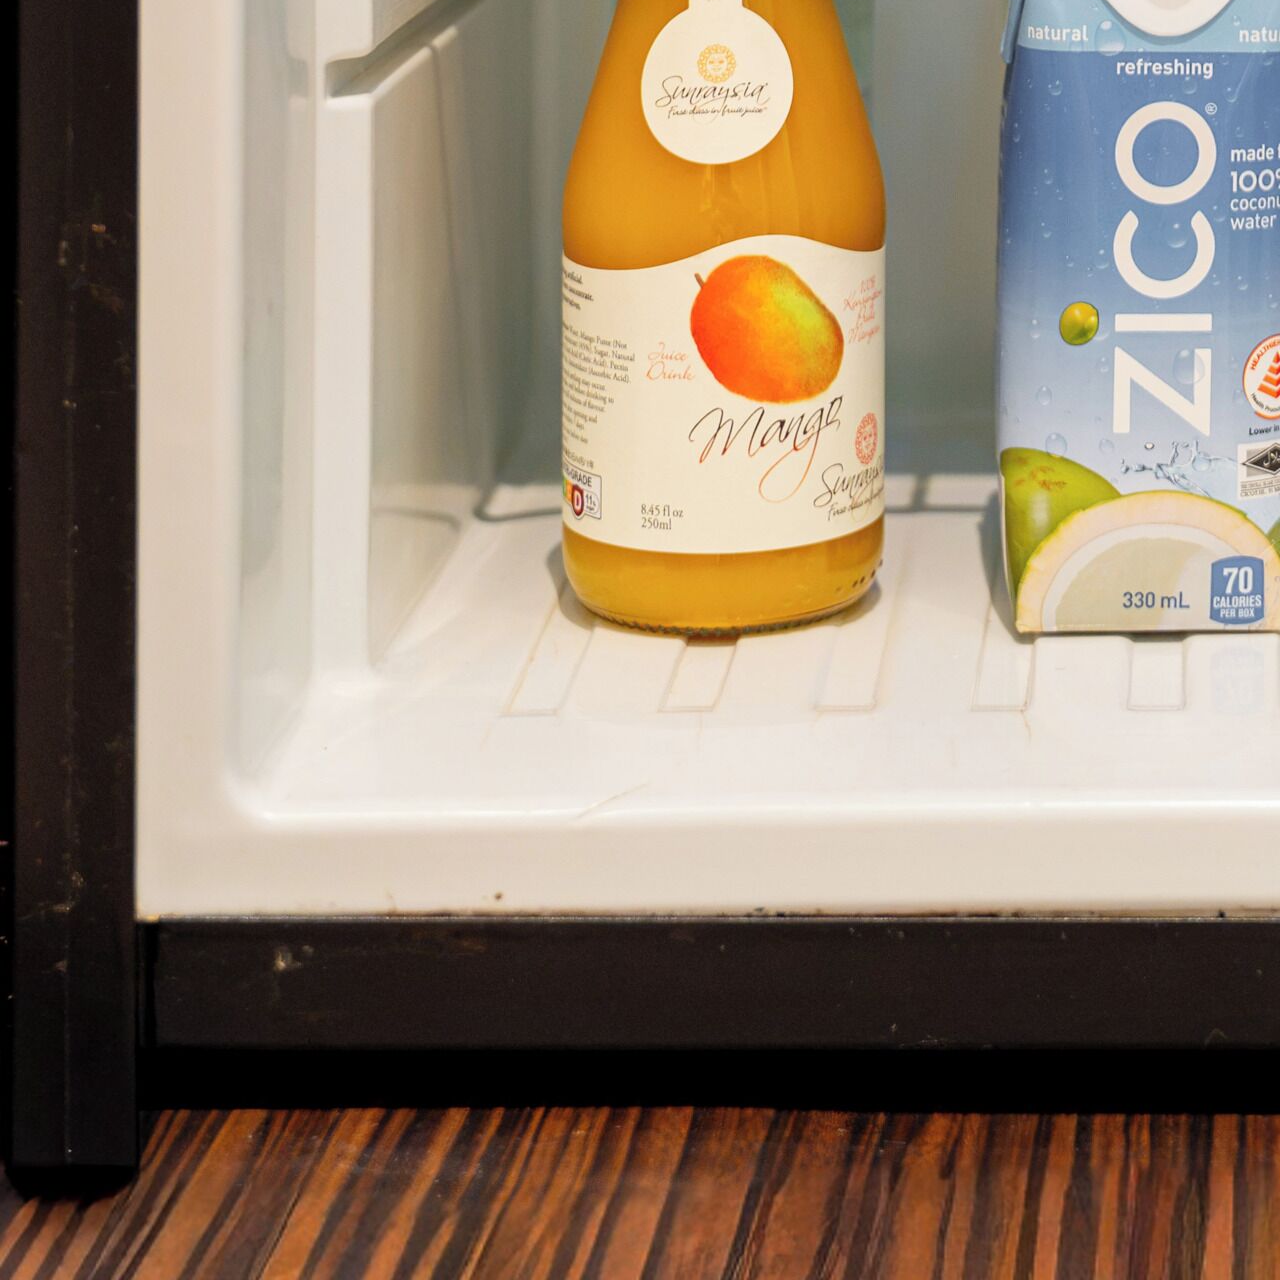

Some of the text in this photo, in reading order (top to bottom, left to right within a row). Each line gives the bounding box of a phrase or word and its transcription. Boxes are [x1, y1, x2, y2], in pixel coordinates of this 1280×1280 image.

[1027, 24, 1089, 41] natural
[1116, 58, 1215, 80] refreshing
[654, 74, 770, 110] Sunraysia
[1230, 143, 1274, 163] made
[1230, 213, 1277, 231] water
[1112, 100, 1217, 438] ZICO
[647, 341, 688, 361] Juice
[646, 360, 696, 382] Drink
[1248, 425, 1272, 437] Lower
[1273, 424, 1280, 432] in
[688, 394, 843, 504] Mango
[640, 503, 684, 518] 8.45 fl oz
[641, 517, 672, 531] 250ml
[1222, 566, 1254, 595] 70
[1122, 591, 1190, 609] 330 mL
[1213, 594, 1262, 609] CALORIES
[1219, 607, 1255, 619] PER BOX
